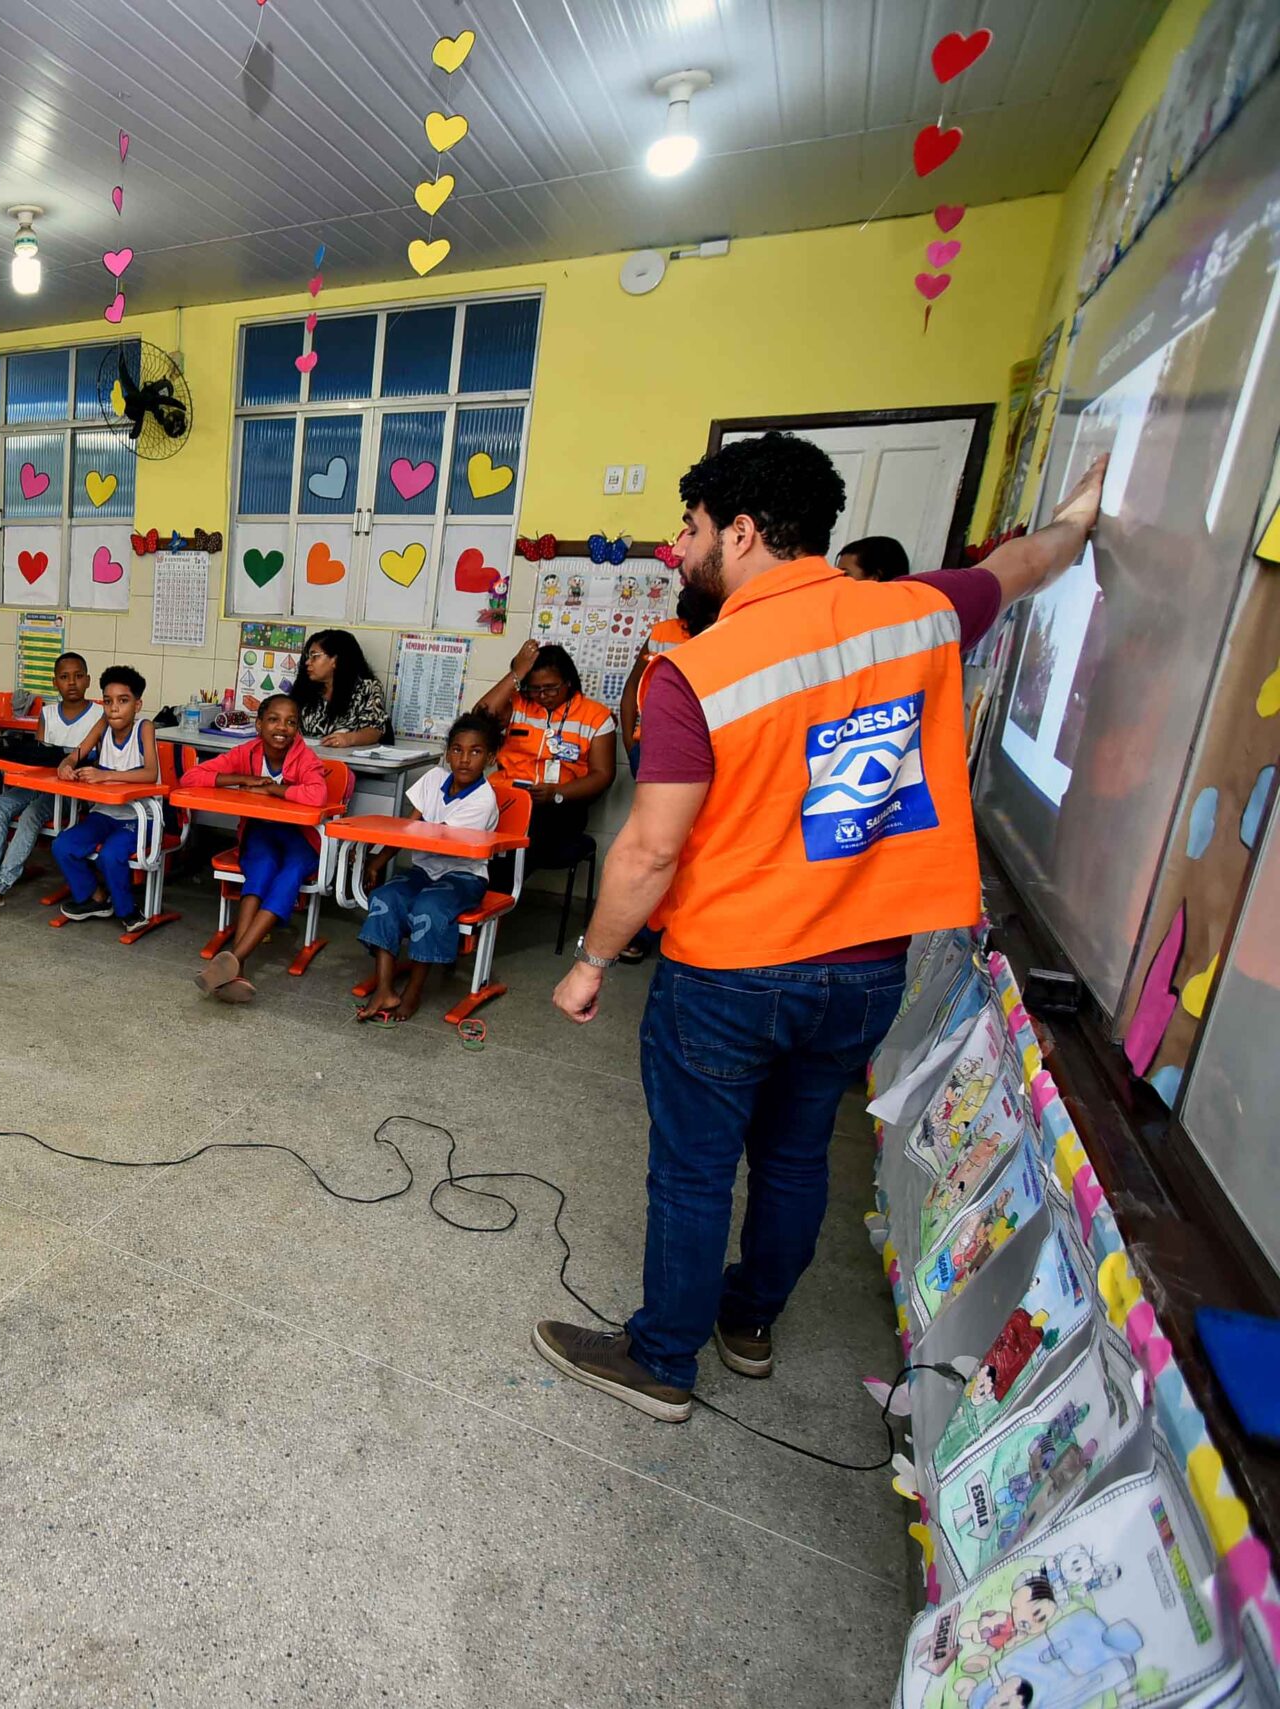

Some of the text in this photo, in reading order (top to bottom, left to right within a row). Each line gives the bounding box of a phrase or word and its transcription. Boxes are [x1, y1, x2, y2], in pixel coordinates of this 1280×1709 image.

[428, 643, 440, 652] POR
[817, 702, 917, 749] CODESAL
[971, 1483, 989, 1528] ESCOLA
[934, 1615, 951, 1661] ESCOLA
